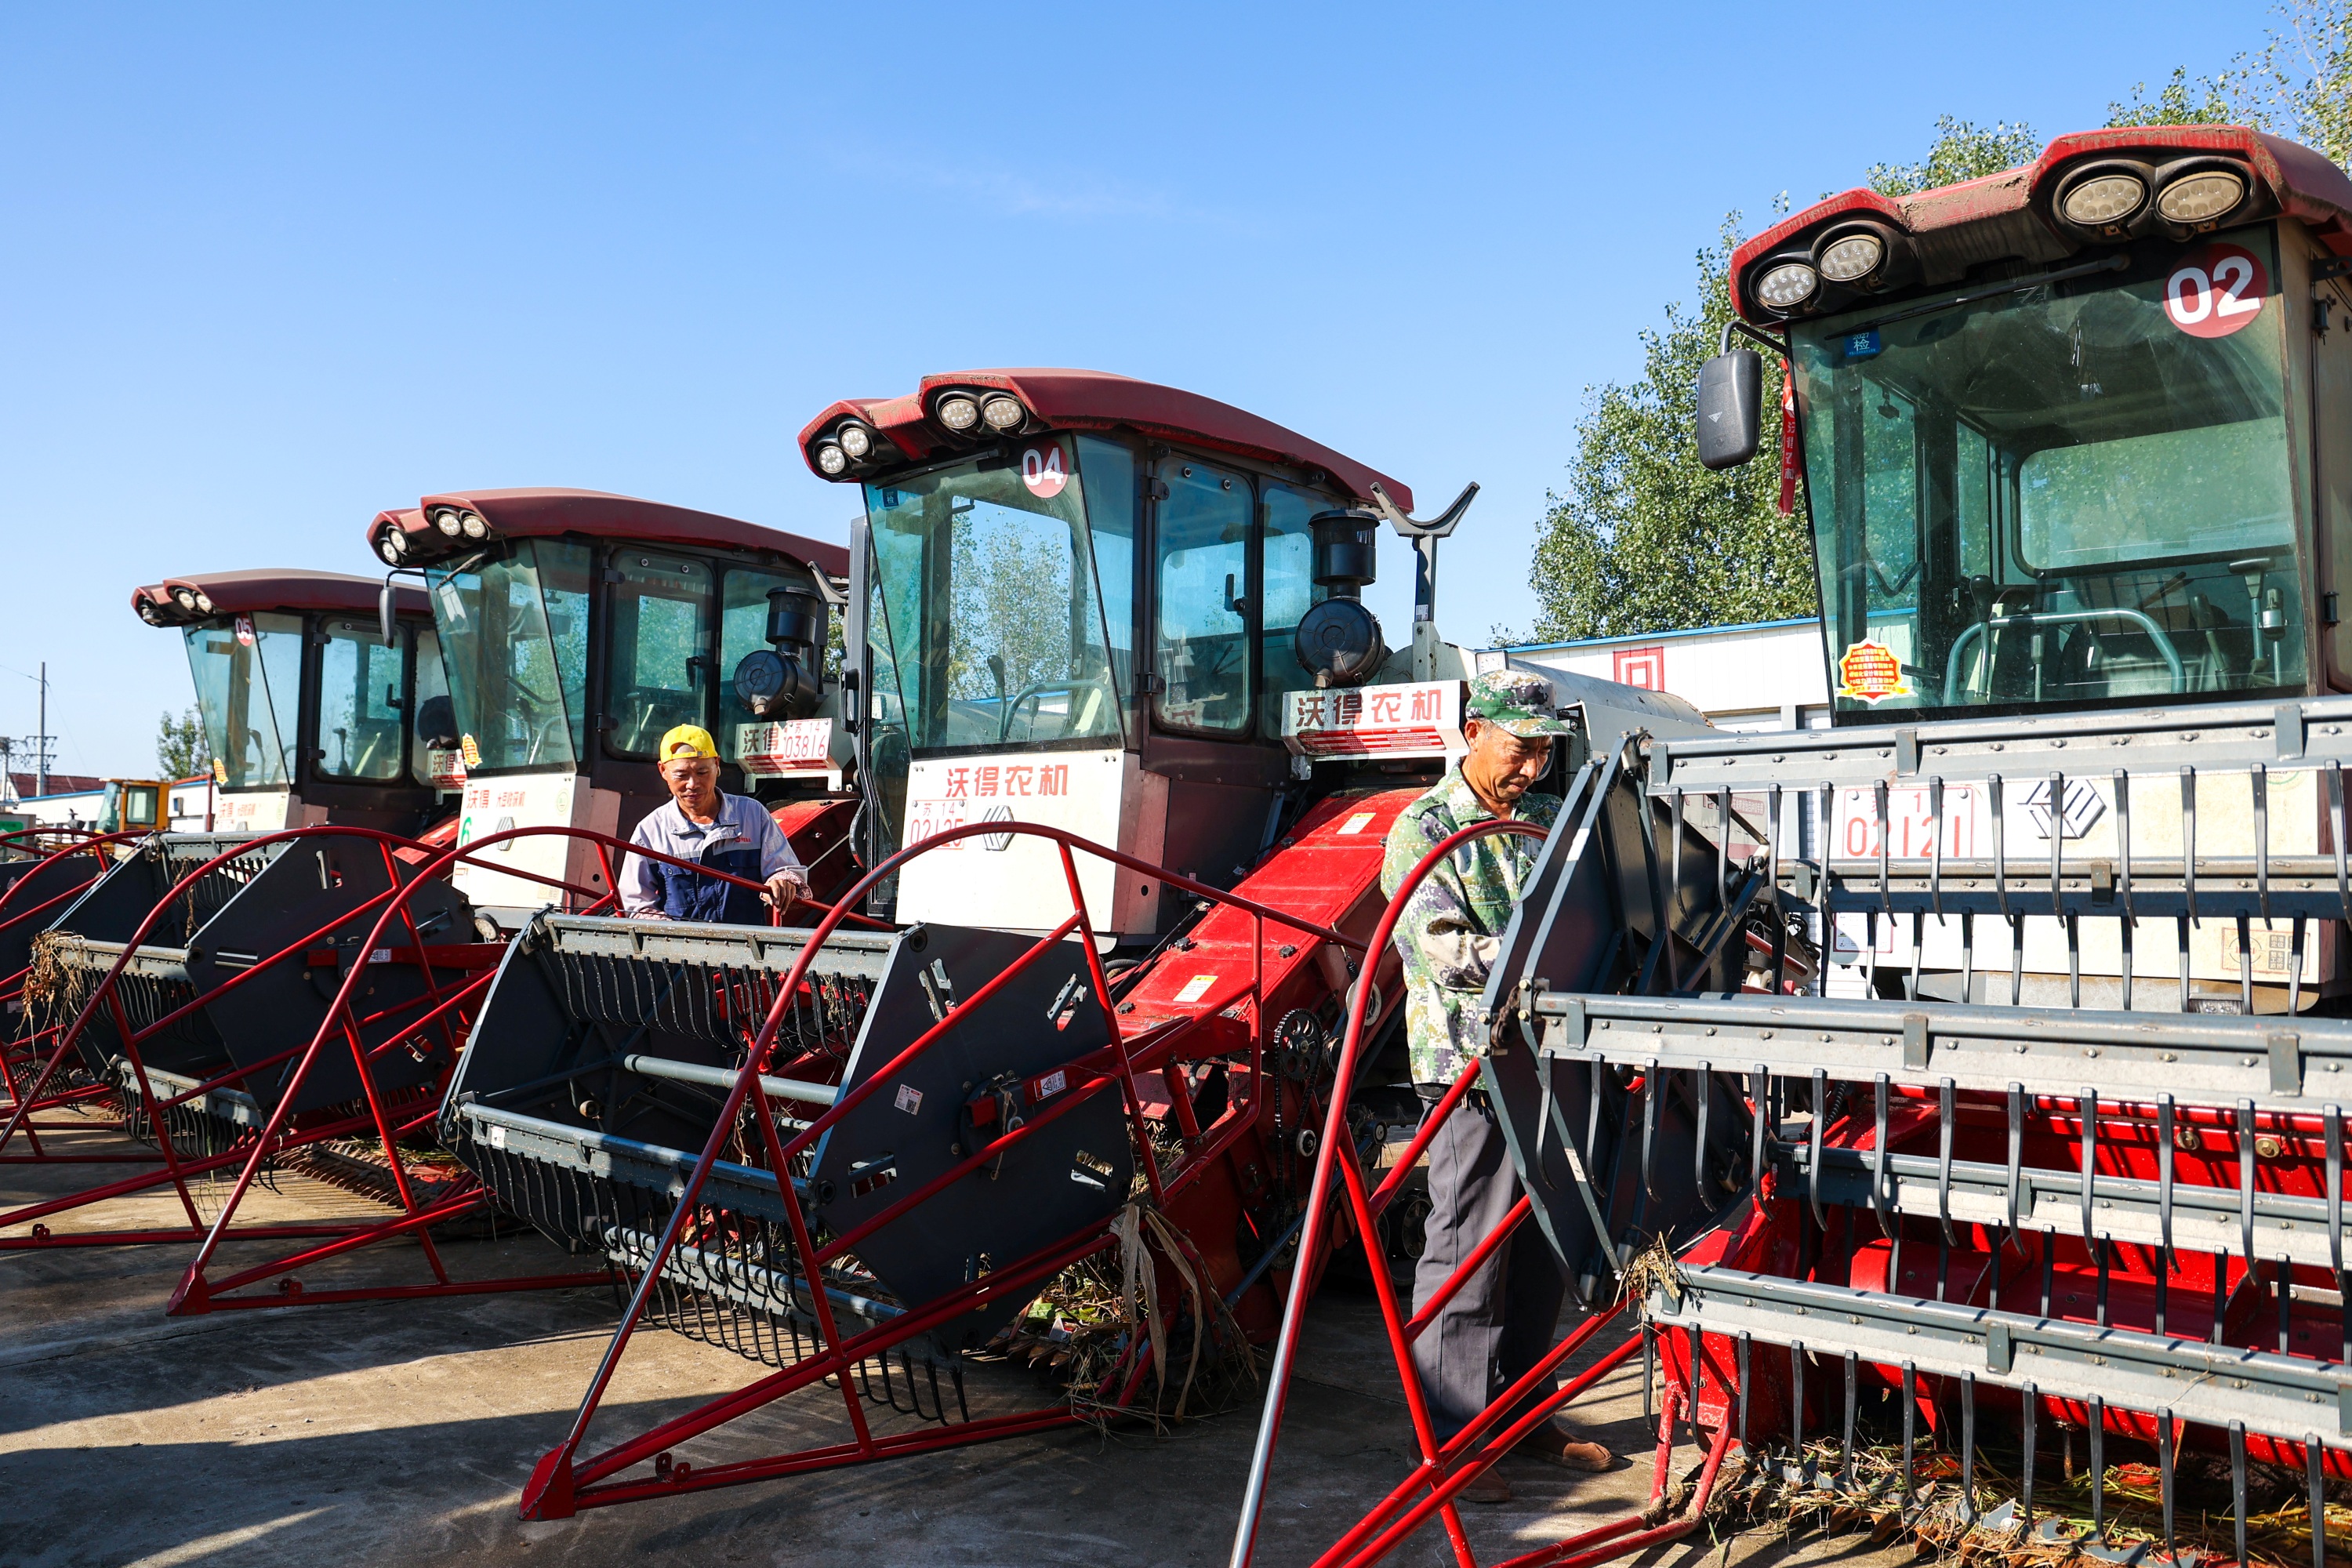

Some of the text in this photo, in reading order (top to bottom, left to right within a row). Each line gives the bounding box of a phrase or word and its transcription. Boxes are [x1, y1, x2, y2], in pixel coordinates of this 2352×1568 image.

[2168, 256, 2260, 324] 02
[1853, 332, 1870, 340] 2027
[1853, 339, 1870, 351] 检
[1022, 447, 1064, 486] 04
[235, 617, 252, 641] 05
[1295, 689, 1442, 728] 沃得农机
[810, 721, 820, 733] 14
[742, 728, 787, 753] 沃得
[785, 735, 826, 758] 03816
[946, 764, 1068, 798] 沃得农机
[466, 789, 490, 809] 沃得
[923, 802, 955, 816] 苏 14
[1846, 815, 1960, 858] 02121
